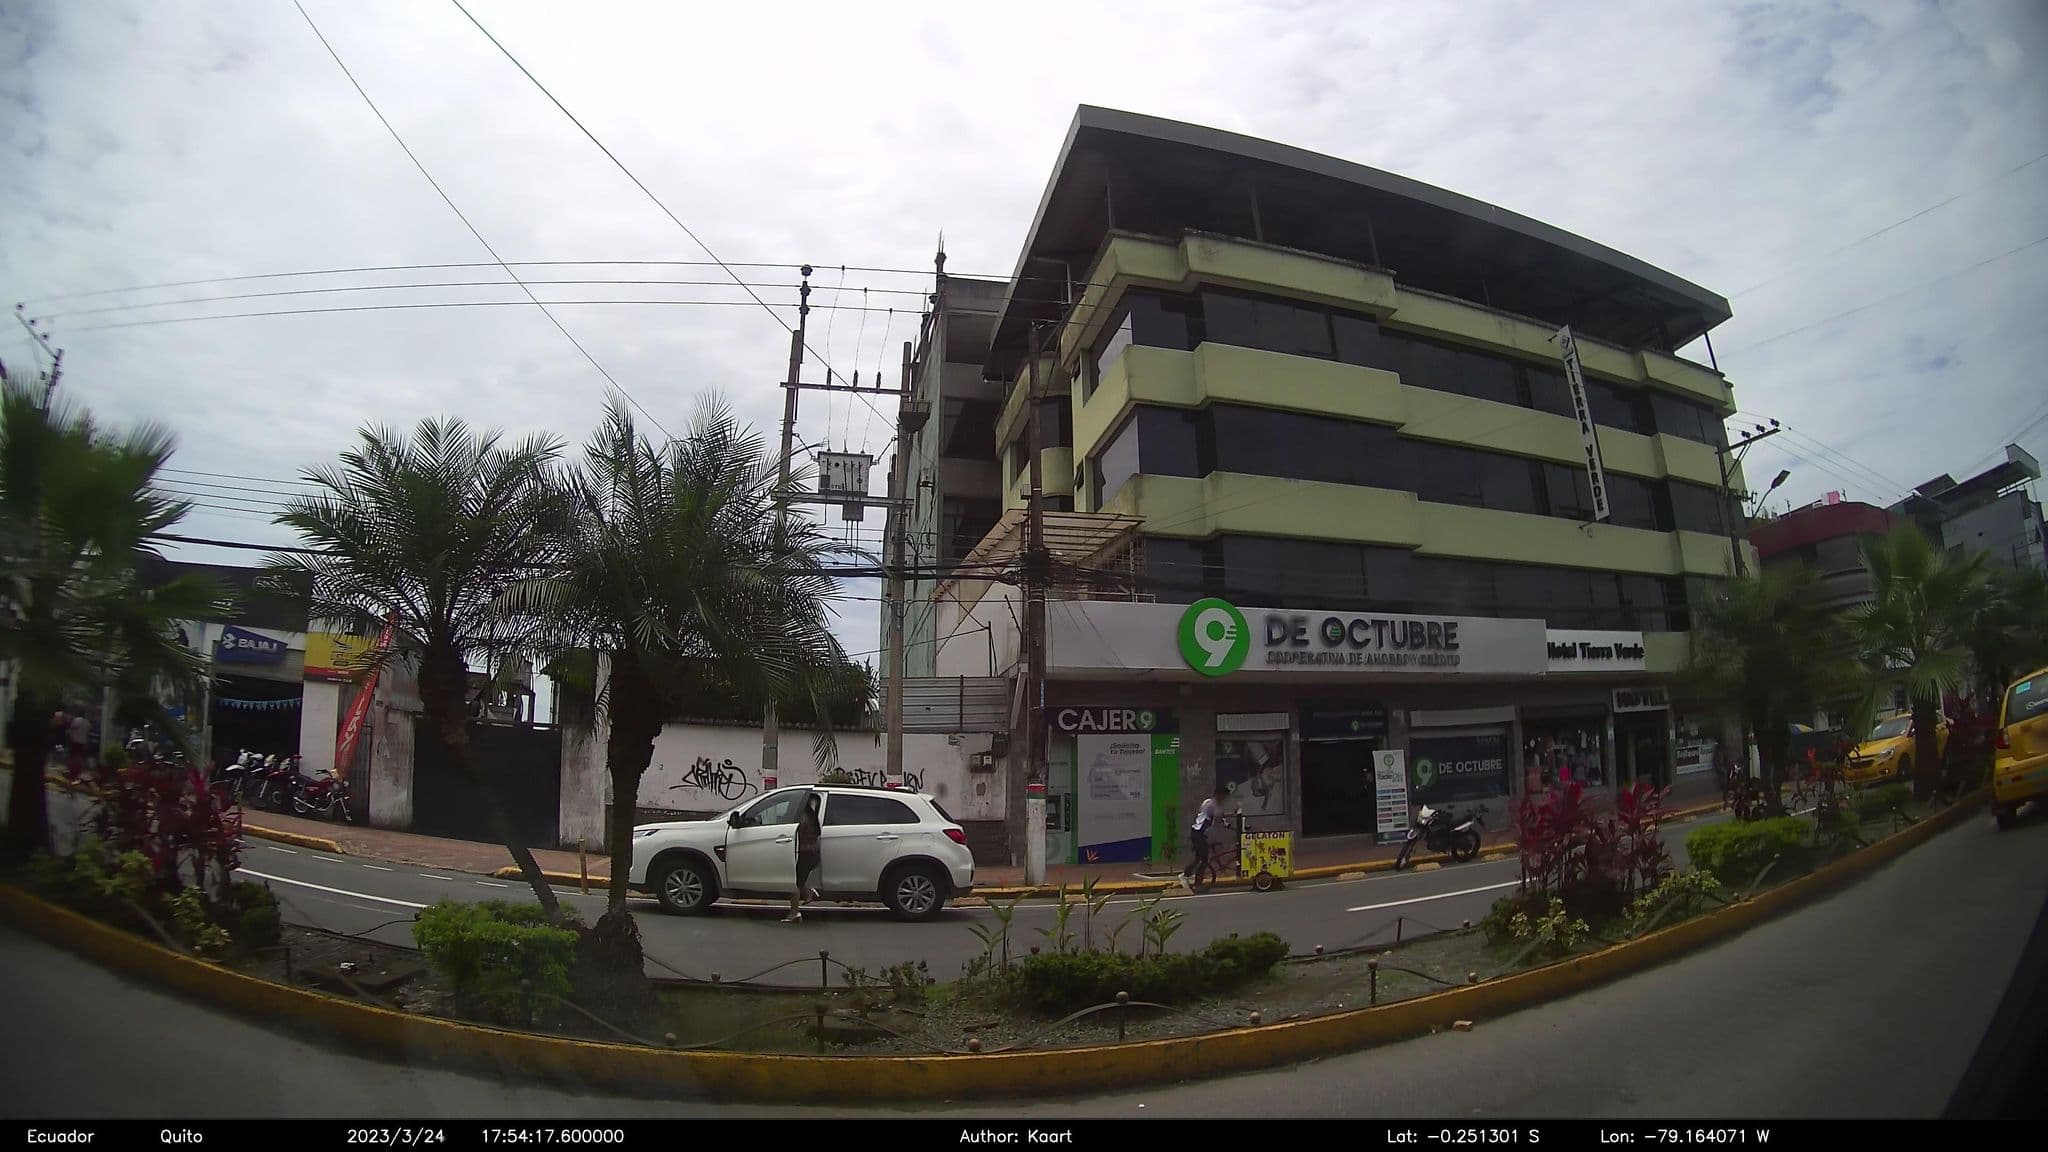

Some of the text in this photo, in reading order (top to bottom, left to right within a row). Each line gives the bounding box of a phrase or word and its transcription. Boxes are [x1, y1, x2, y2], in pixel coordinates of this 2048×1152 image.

[1566, 358, 1605, 512] TIERRA VERDE
[237, 638, 279, 652] BAJAJ
[1194, 607, 1460, 667] 9 DE OCTUBRE
[1266, 650, 1345, 665] COOPERATIVA
[1346, 652, 1363, 665] DE
[1547, 642, 1645, 659] Hotel Tierra Verde
[1439, 761, 1453, 774] DE
[1455, 758, 1504, 773] OCTUBRE
